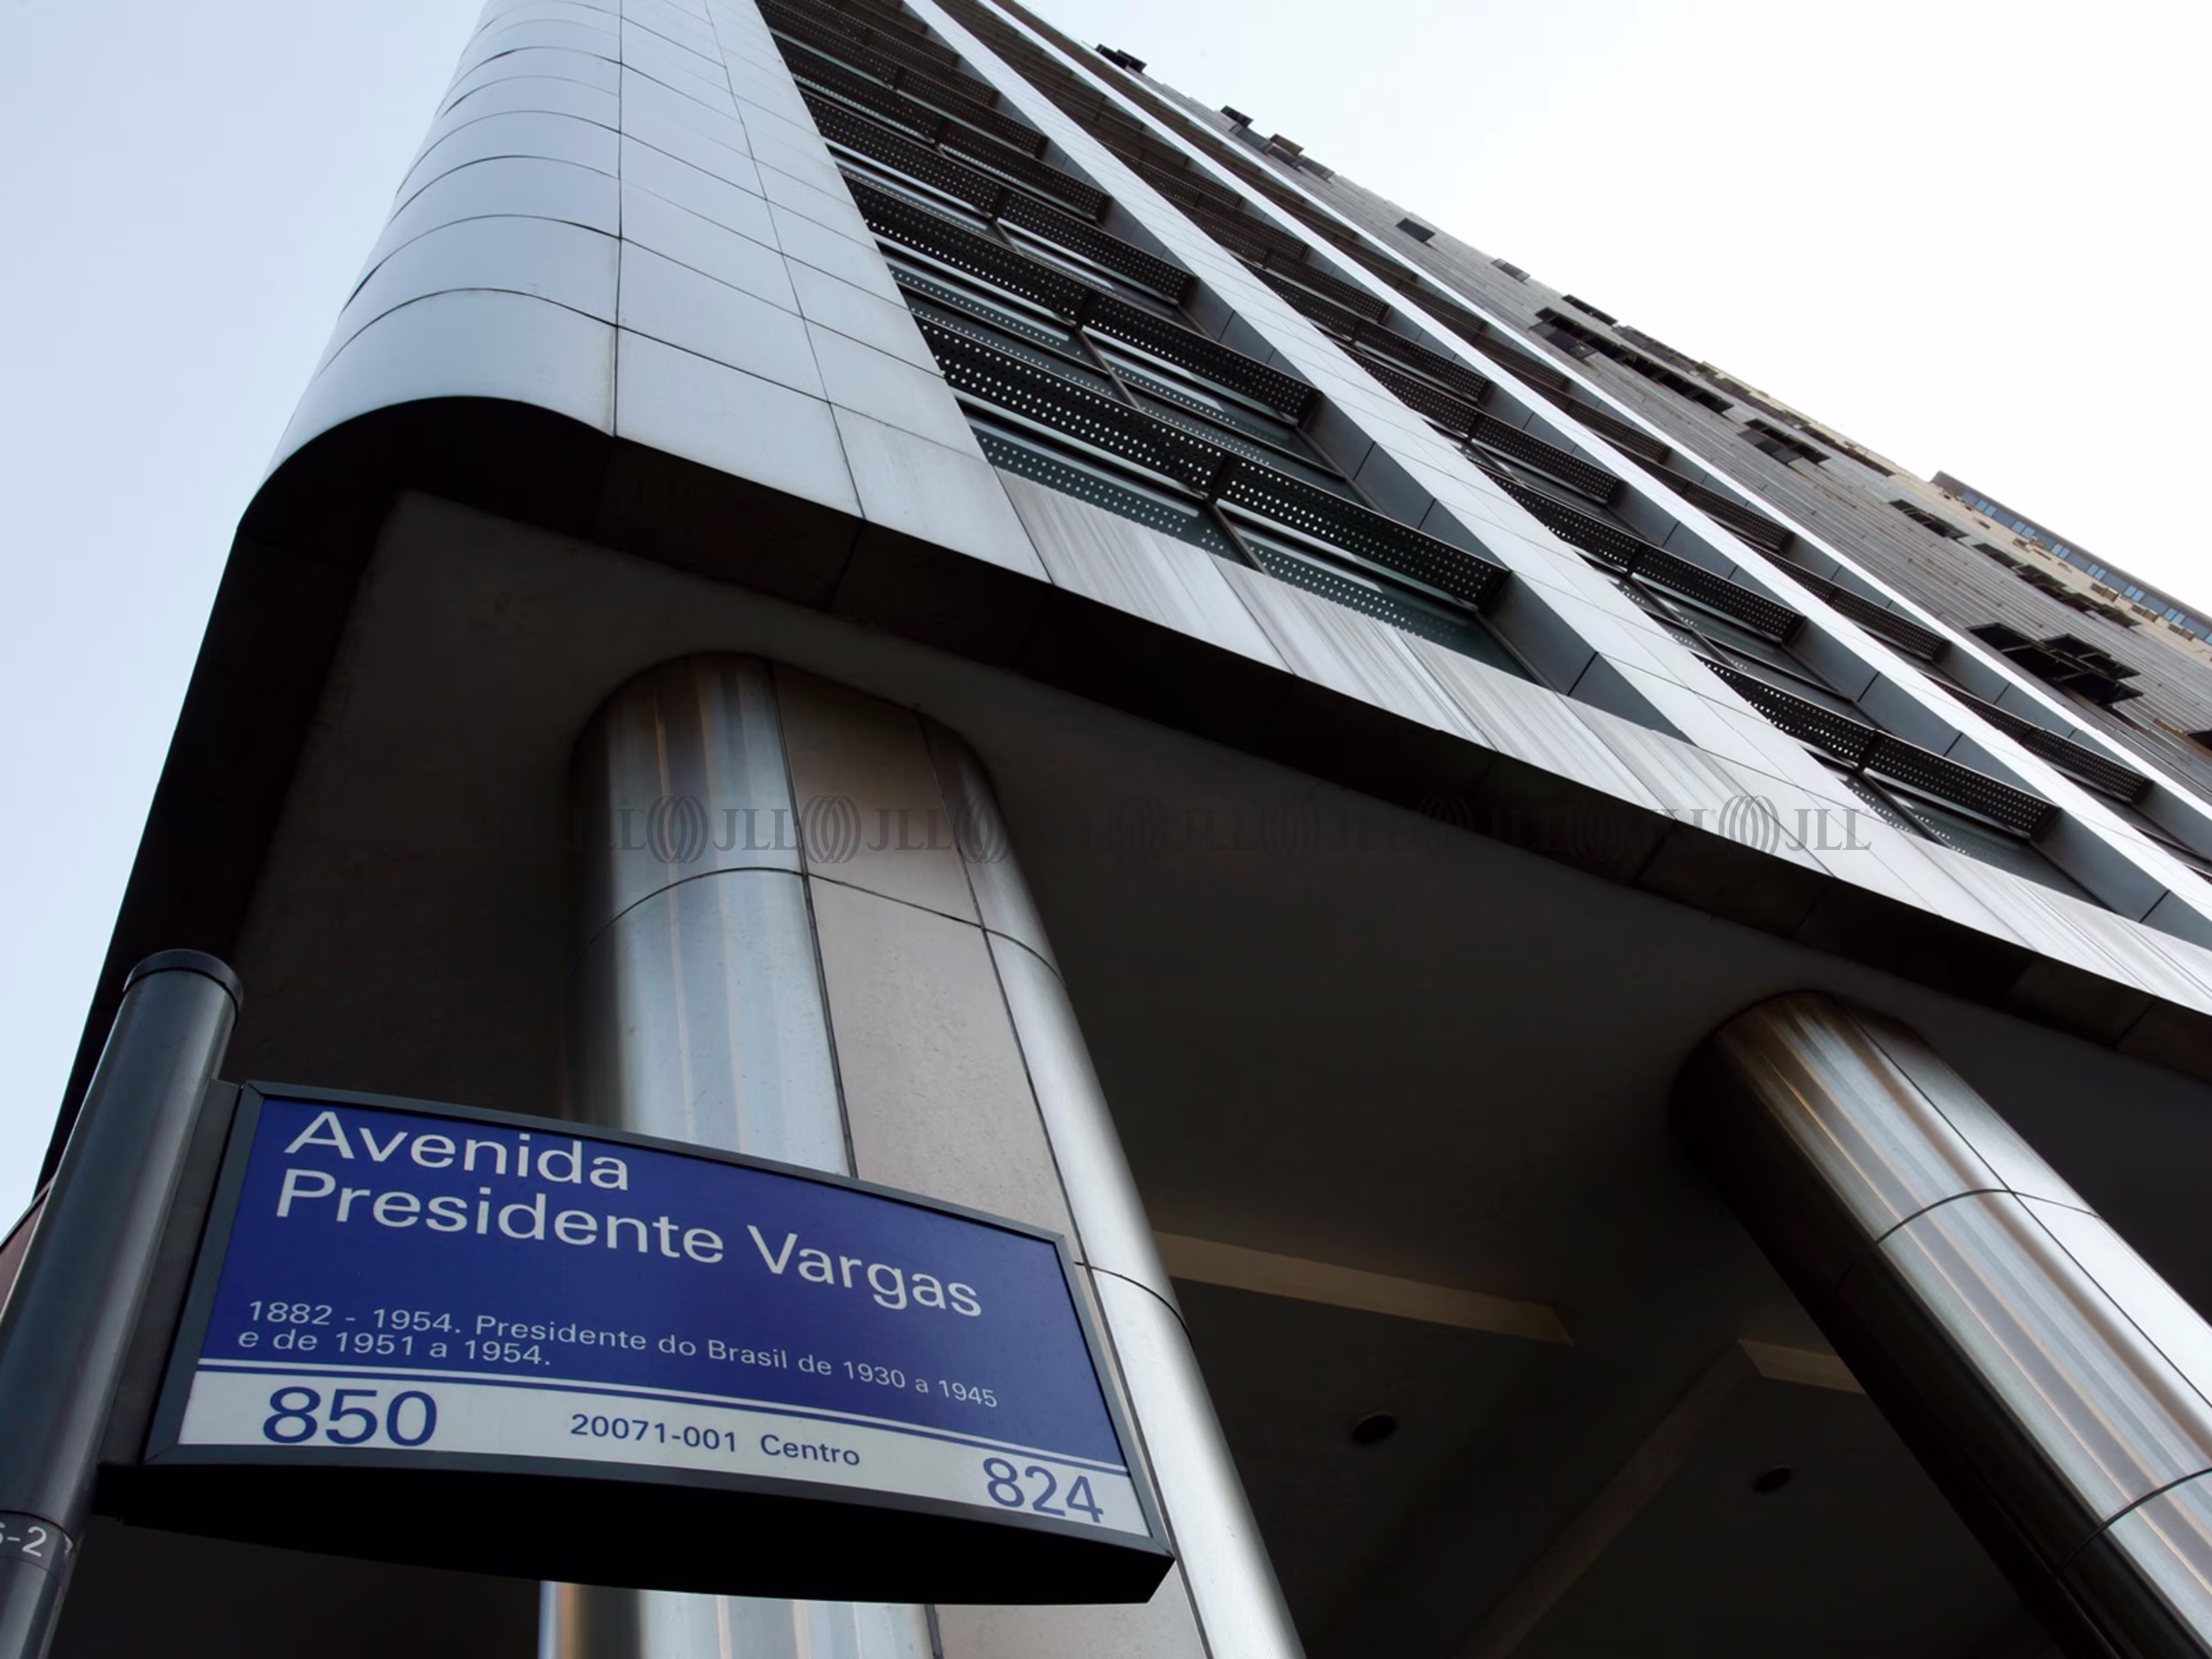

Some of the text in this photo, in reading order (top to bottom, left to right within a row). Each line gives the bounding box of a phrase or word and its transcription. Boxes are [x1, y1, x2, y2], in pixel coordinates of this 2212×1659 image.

[284, 1111, 628, 1191] Avenida
[276, 1168, 982, 1317] Presidente Vargas
[238, 1328, 551, 1366] e de 1951 a 1954.
[249, 1300, 332, 1325] 1882
[373, 1309, 461, 1334] 1954.
[476, 1315, 646, 1350] Presidente
[658, 1334, 696, 1356] do
[708, 1339, 787, 1369] Brasil
[798, 1354, 832, 1376] de
[843, 1361, 906, 1389] 1930
[915, 1378, 929, 1393] a
[938, 1380, 998, 1408] 1945
[262, 1386, 438, 1447] 850
[570, 1413, 861, 1467] 20071-001 Centro
[982, 1457, 1104, 1524] 824
